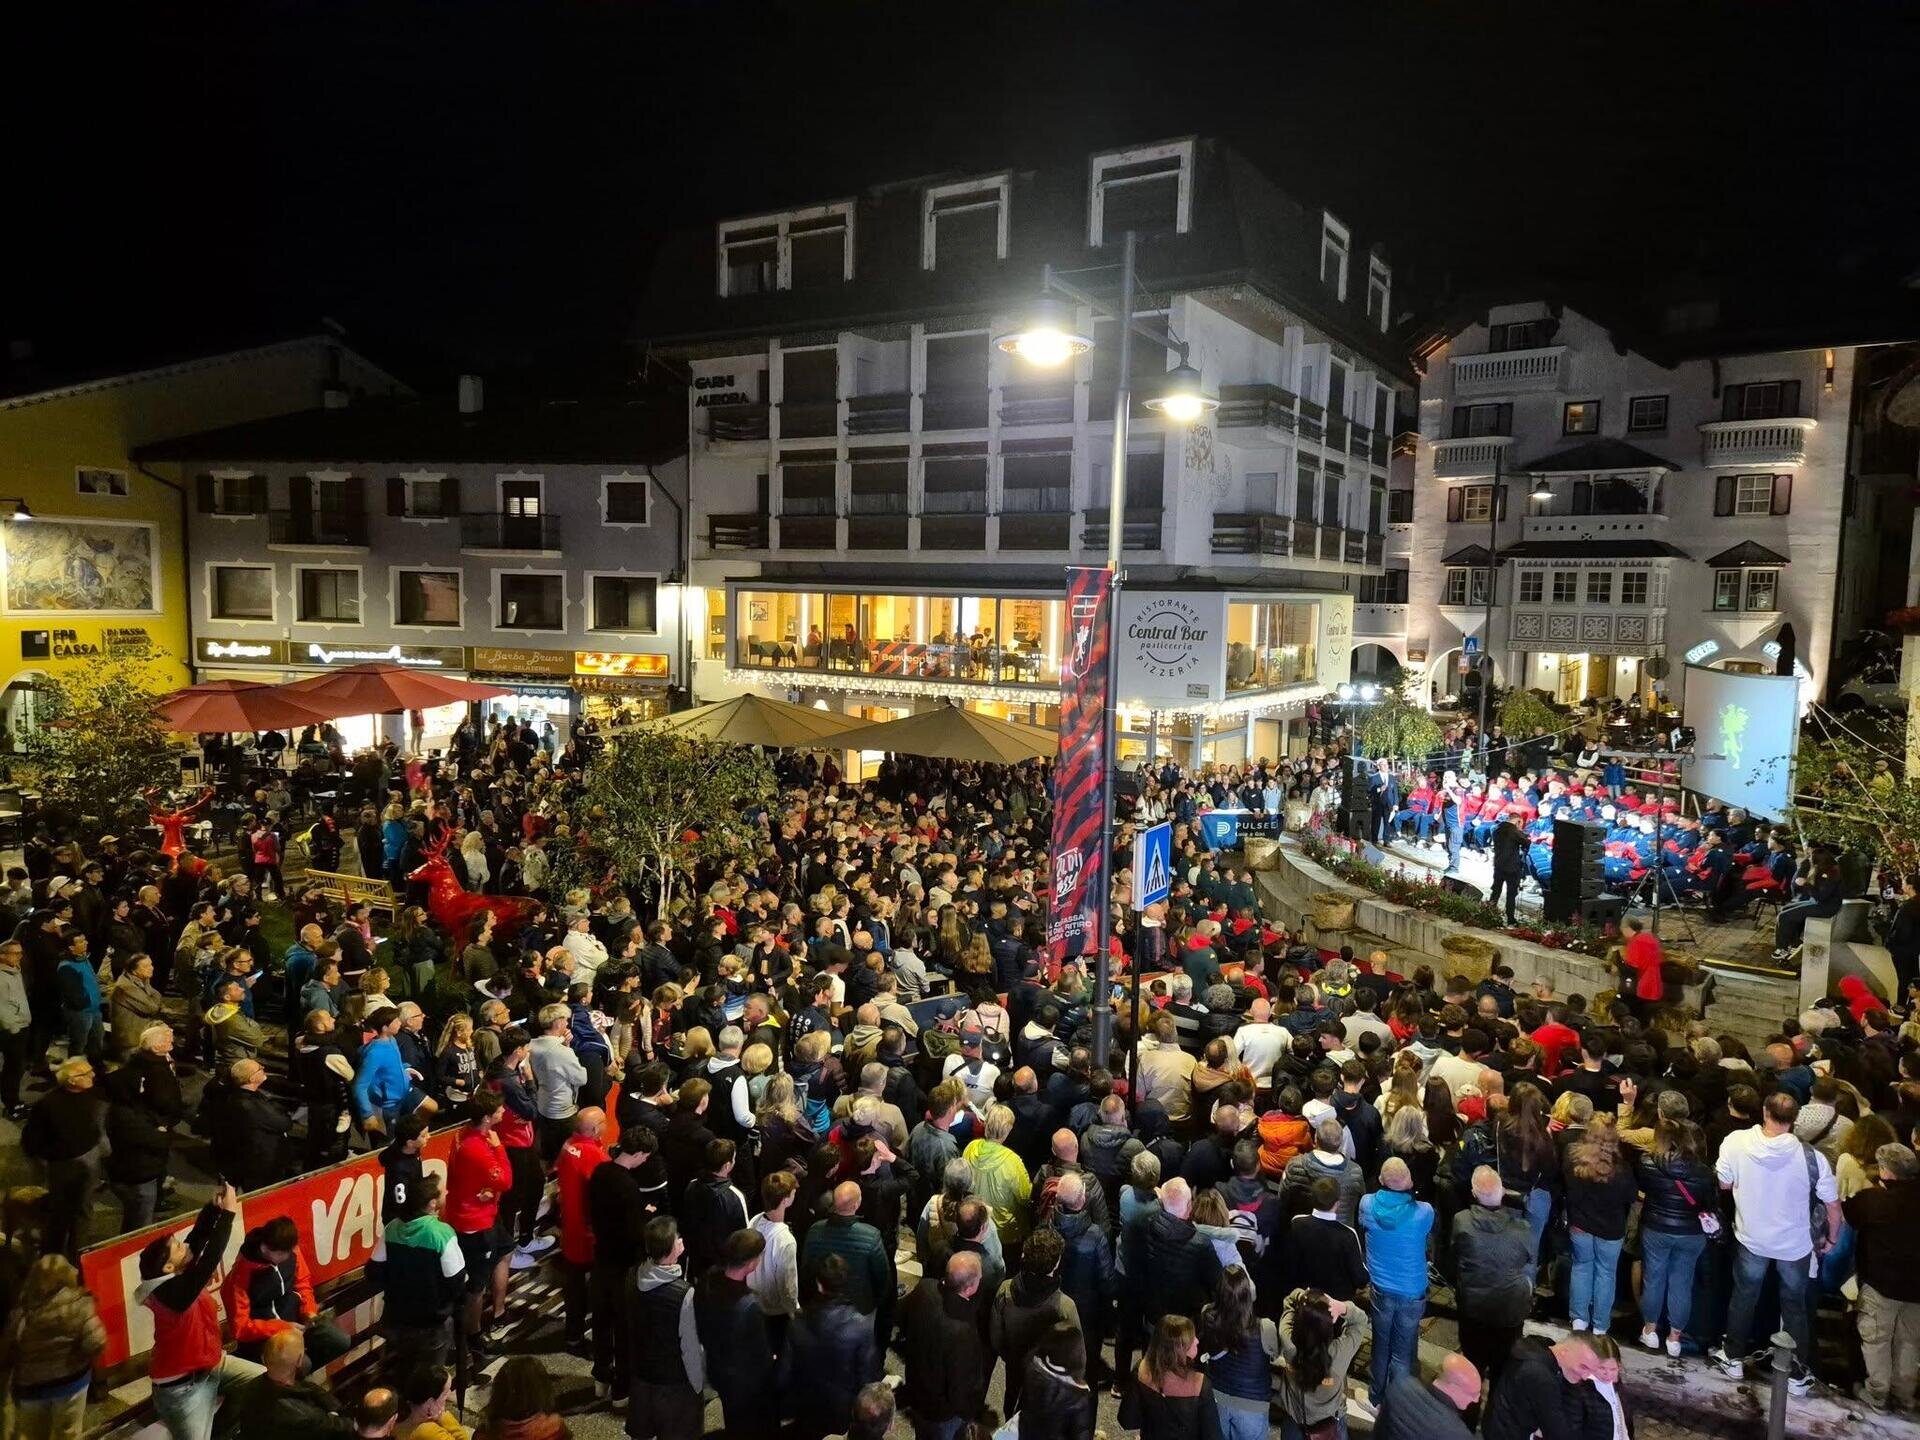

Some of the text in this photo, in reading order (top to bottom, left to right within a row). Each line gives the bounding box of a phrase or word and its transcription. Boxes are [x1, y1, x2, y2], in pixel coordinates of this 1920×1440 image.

[1136, 599, 1200, 624] RISTORANTE
[1128, 623, 1208, 642] Central Bar
[526, 652, 565, 666] Bruno
[1135, 654, 1200, 678] PIZZERIA
[1064, 920, 1093, 931] RITIRO
[1064, 928, 1081, 938] CFC
